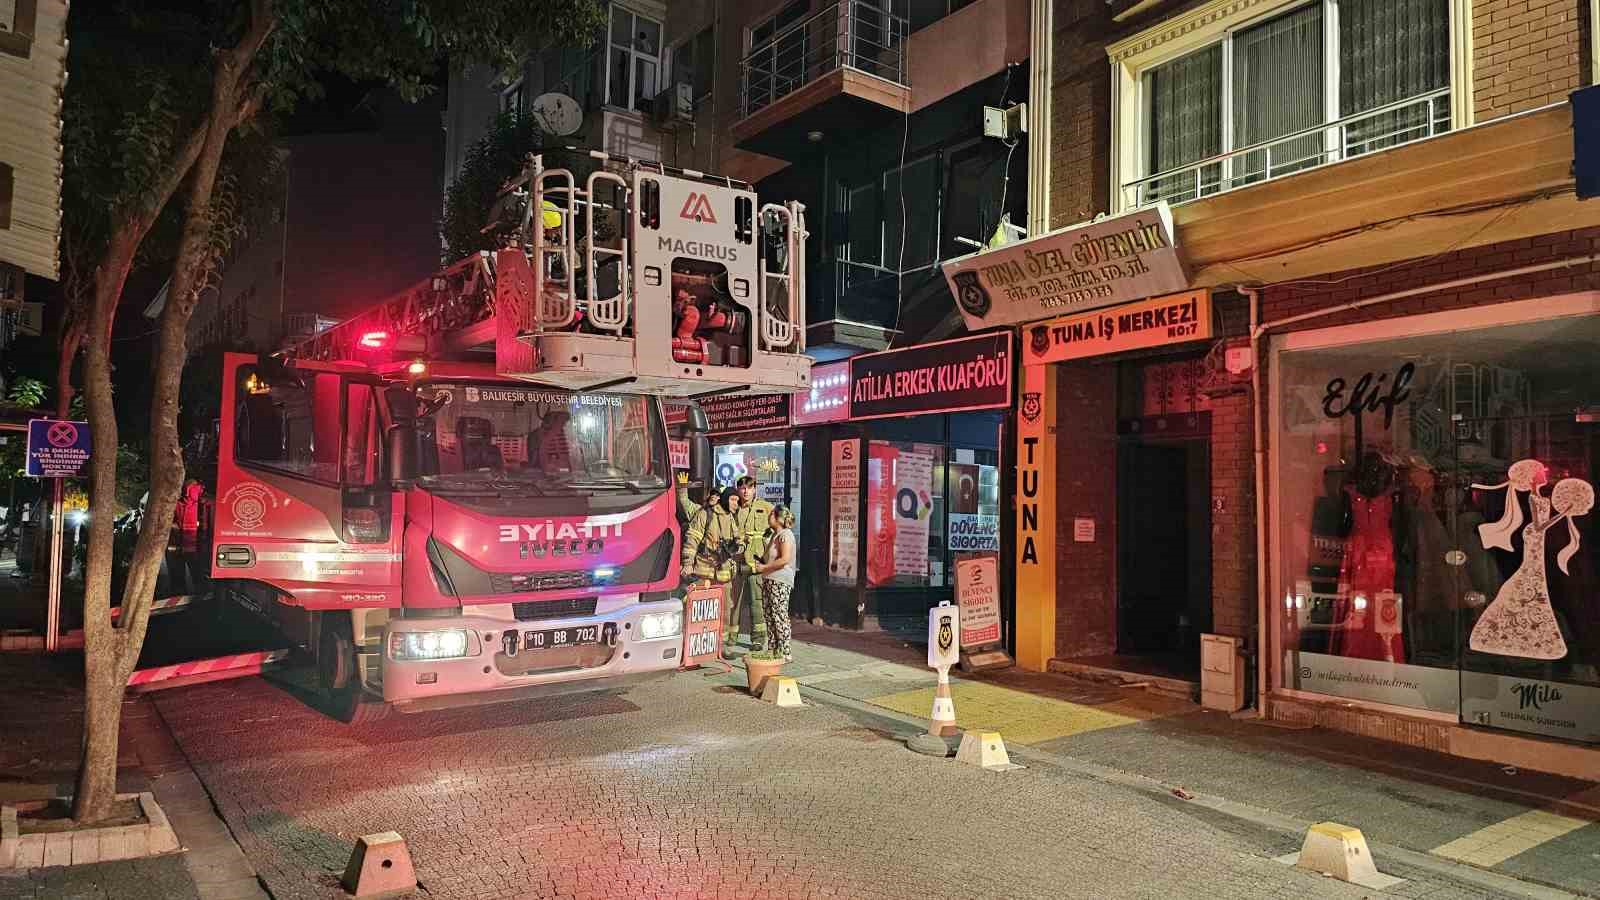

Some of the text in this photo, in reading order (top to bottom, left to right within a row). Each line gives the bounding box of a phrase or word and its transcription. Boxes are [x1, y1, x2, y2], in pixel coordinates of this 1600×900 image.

[658, 237, 737, 262] MAGIRUS
[981, 220, 1166, 289] TUNA ÖZEL GÜVENLİK
[1100, 264, 1125, 282] LTD.
[1052, 298, 1198, 345] TUNA İŞ MERKEZİ
[854, 352, 1008, 402] ATİLLA ERKEK KUAFÖRÜ
[1322, 362, 1415, 430] Elif
[1021, 437, 1039, 564] TUNA
[519, 538, 605, 560] IVECO
[692, 599, 719, 622] DUVAR
[533, 632, 544, 646] 10
[554, 630, 567, 644] BB
[576, 628, 594, 642] 702
[689, 627, 717, 657] KAĞIDI
[1510, 682, 1563, 710] Mila
